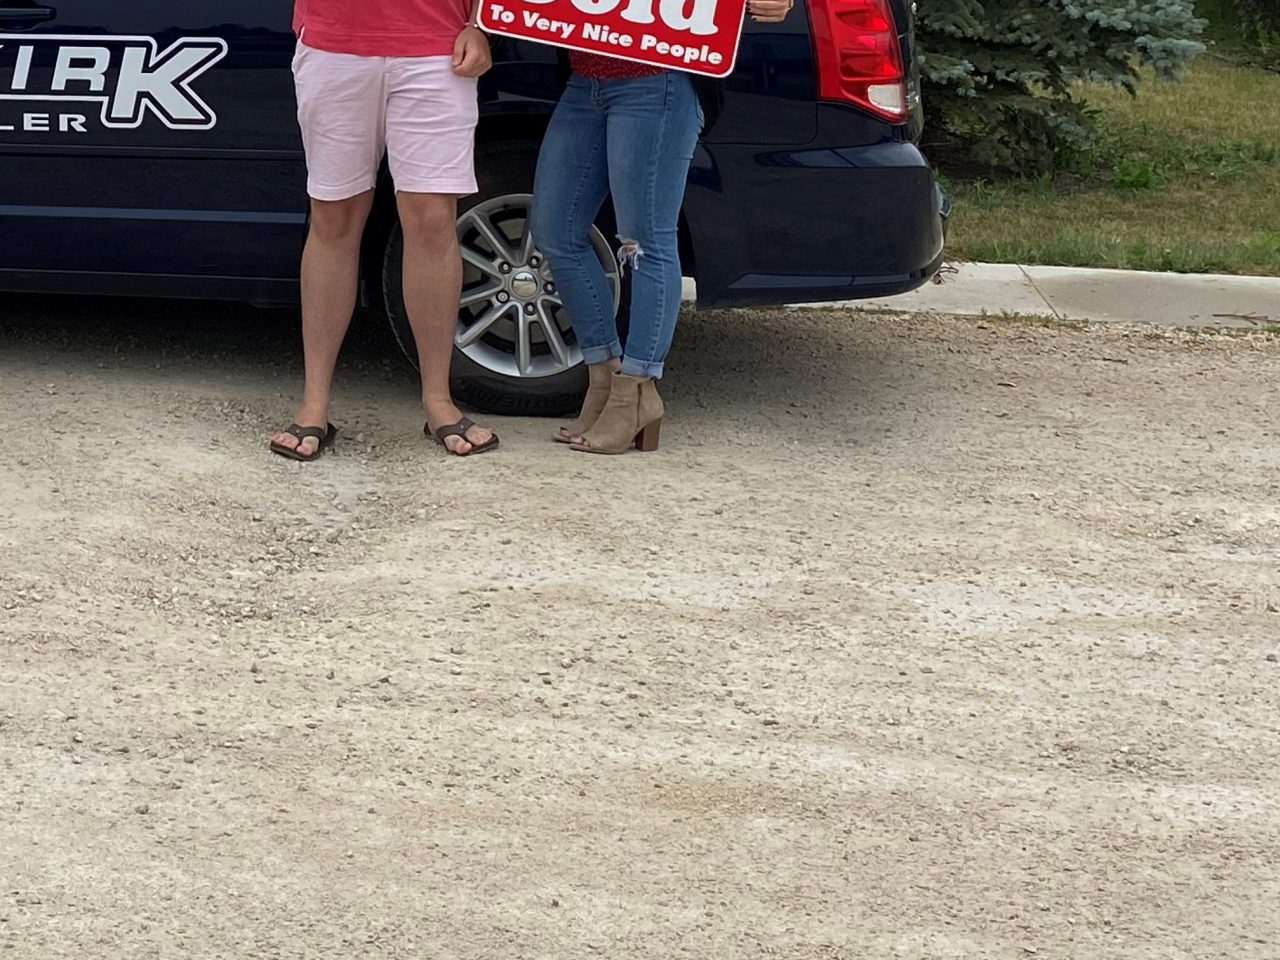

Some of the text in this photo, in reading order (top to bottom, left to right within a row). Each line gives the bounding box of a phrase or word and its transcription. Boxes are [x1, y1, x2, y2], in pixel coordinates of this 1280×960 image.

[490, 4, 723, 65] To Very Nice People
